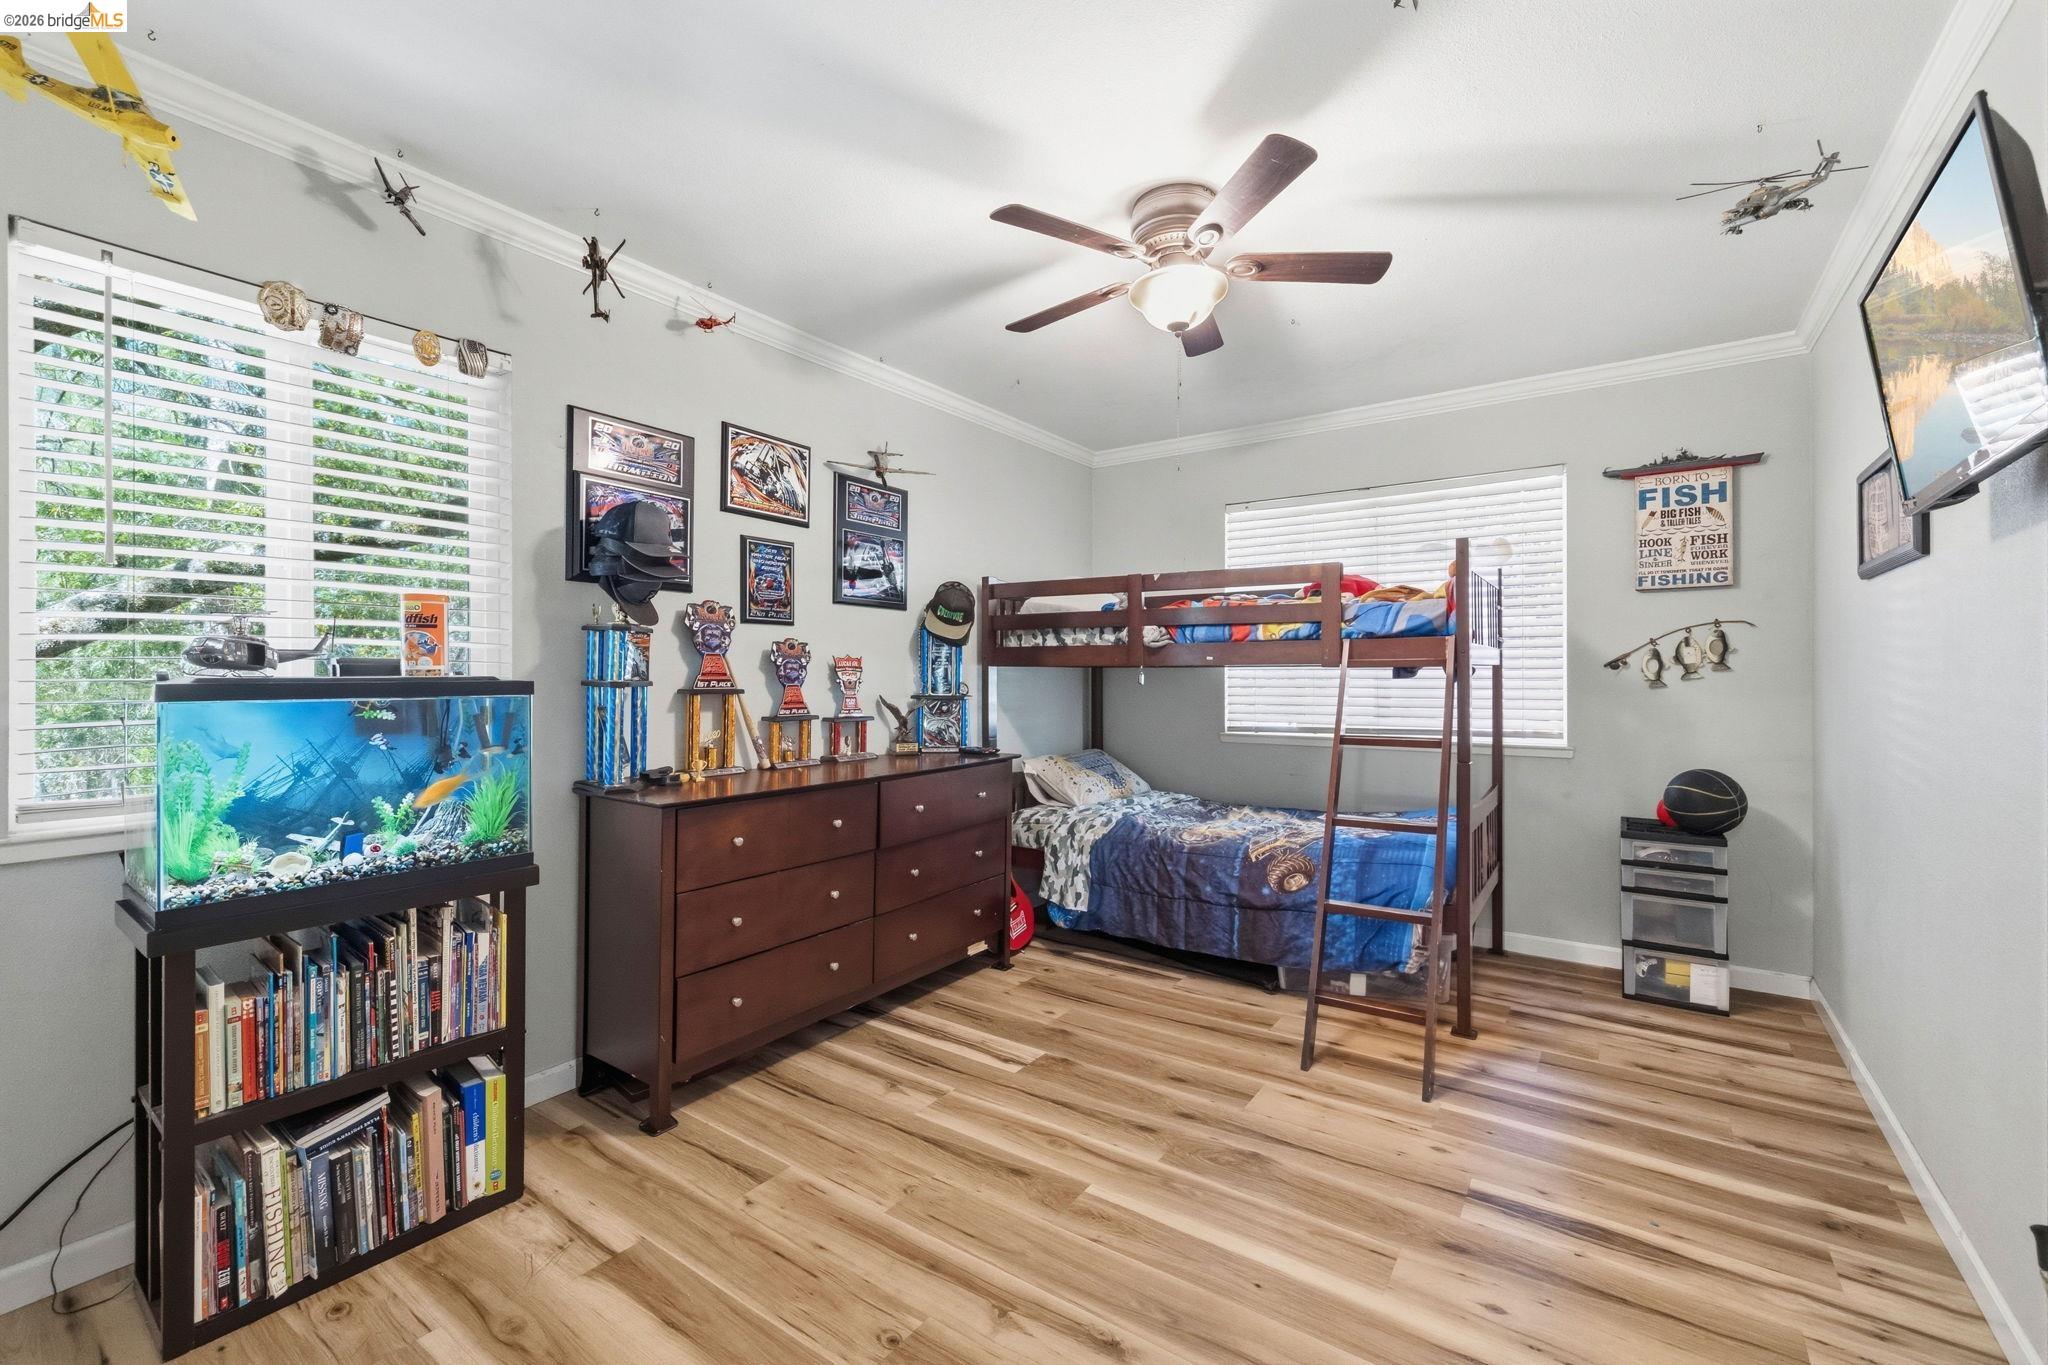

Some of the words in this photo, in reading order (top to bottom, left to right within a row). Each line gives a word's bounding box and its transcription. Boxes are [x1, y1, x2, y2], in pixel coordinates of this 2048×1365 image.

[594, 422, 614, 434] 20
[662, 440, 680, 450] 20
[1655, 474, 1690, 486] BORN
[1695, 472, 1710, 482] TO
[1638, 481, 1728, 510] FISH
[1660, 509, 1677, 520] BIG
[1680, 506, 1701, 518] FISH
[1667, 518, 1686, 526] TALLER
[1686, 516, 1702, 525] TALES
[1639, 537, 1672, 548] HOOK
[1690, 532, 1728, 546] FISH
[1639, 548, 1672, 560] LINE
[1690, 548, 1728, 560] WORK
[1639, 560, 1672, 568] SINKER
[1638, 571, 1728, 587] FISHING
[478, 979, 488, 1004] NEVADA
[472, 1112, 480, 1142] children's
[320, 1139, 336, 1150] GUIDE
[317, 1171, 328, 1210] MISSING
[265, 1188, 286, 1279] FISHING
